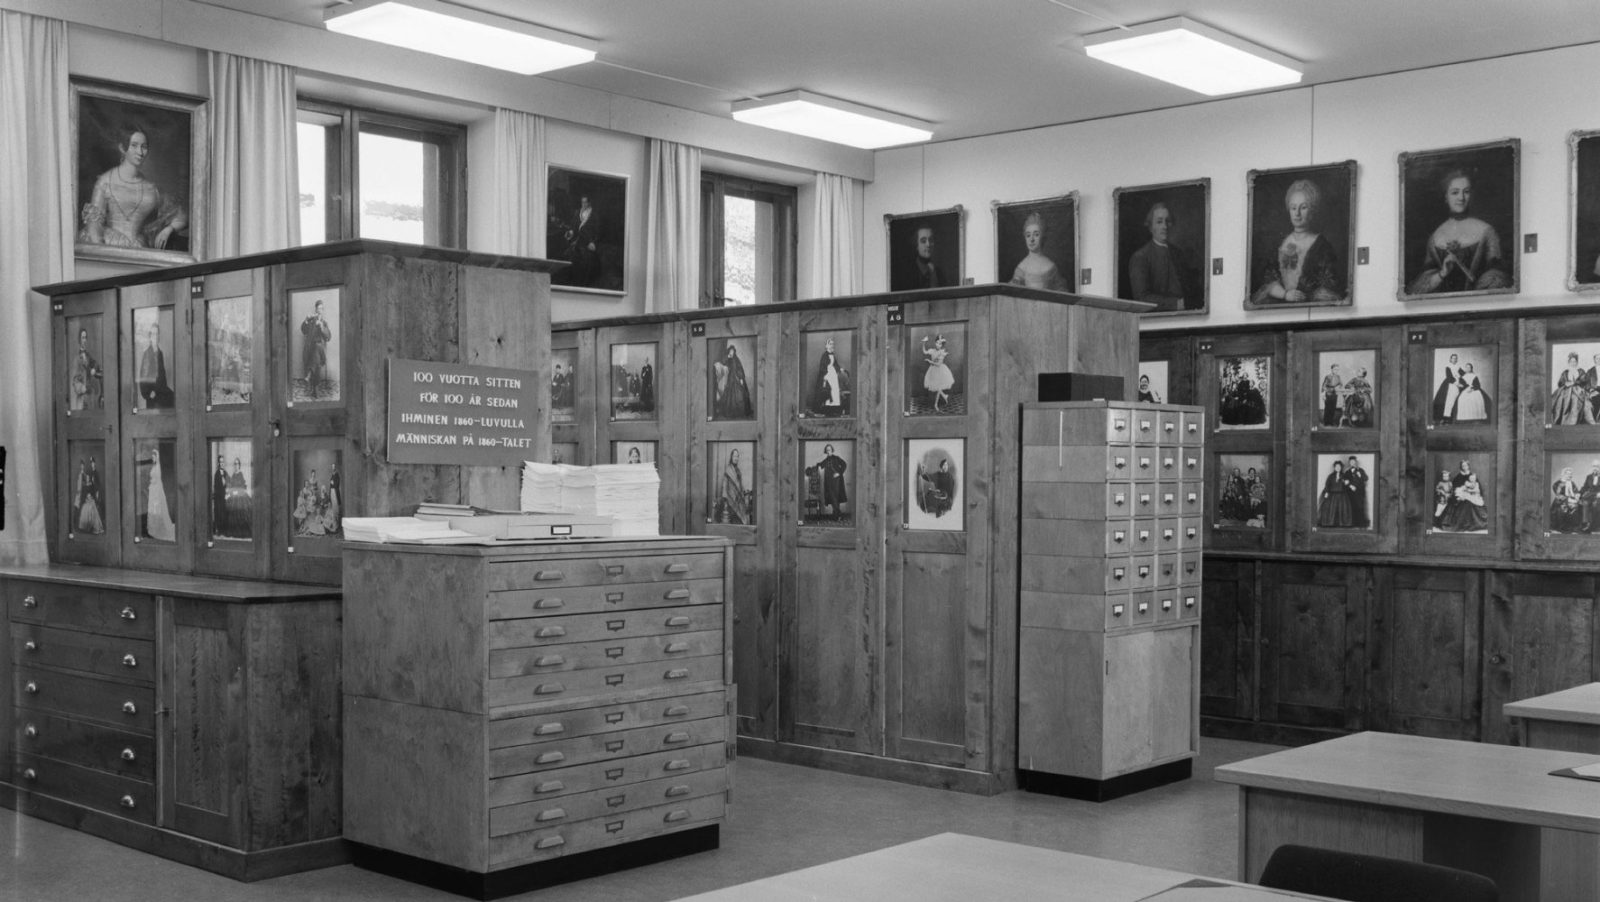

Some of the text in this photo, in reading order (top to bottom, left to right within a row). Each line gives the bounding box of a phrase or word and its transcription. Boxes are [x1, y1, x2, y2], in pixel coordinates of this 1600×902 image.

[413, 372, 521, 389] 100 VUOTTA SITTEN
[420, 392, 518, 408] FÖR 100 ÅR SEDAN
[402, 413, 524, 428] IHMINEN 1860-LUVULLA
[396, 433, 532, 448] MÄNNISKAN PÅ 1860-TALET
